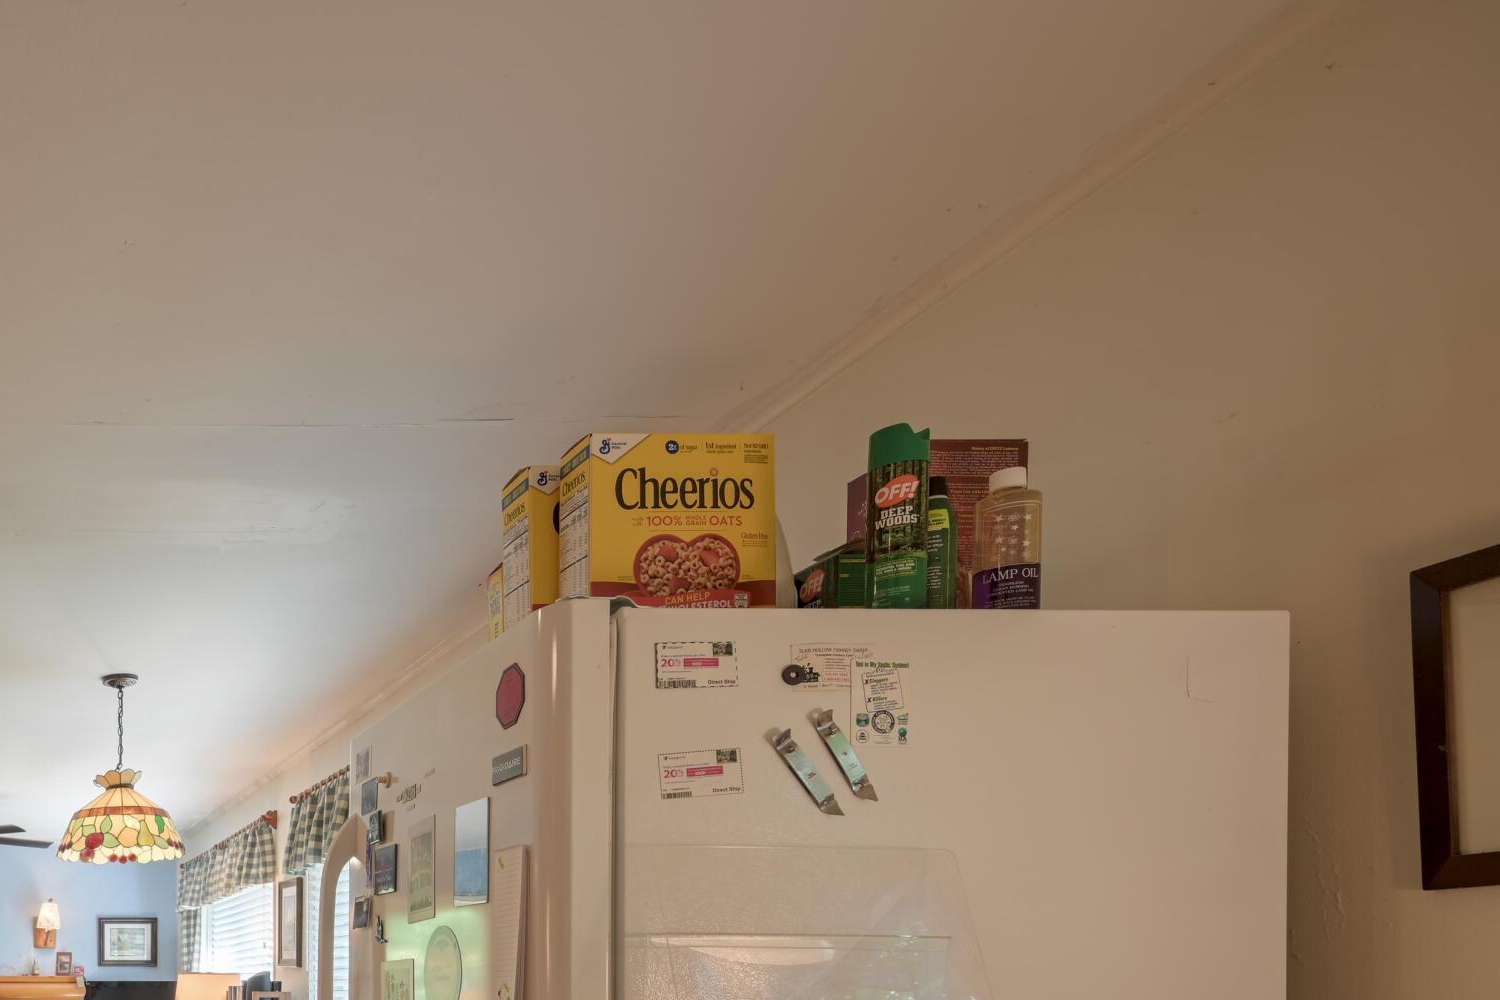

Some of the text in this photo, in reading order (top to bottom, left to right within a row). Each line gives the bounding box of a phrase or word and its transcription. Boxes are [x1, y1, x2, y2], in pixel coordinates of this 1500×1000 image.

[562, 471, 586, 497] Cheerios
[615, 467, 755, 510] Cheerios
[874, 480, 920, 504] OFF!
[880, 505, 913, 520] DEEP
[645, 515, 683, 527] 100%
[709, 515, 743, 527] OATS
[875, 514, 918, 530] WOODS
[982, 566, 1039, 585] LAMP OIL
[800, 574, 825, 599] OFF!
[659, 599, 733, 609] OLESTEROL
[665, 591, 711, 605] CAN HELP
